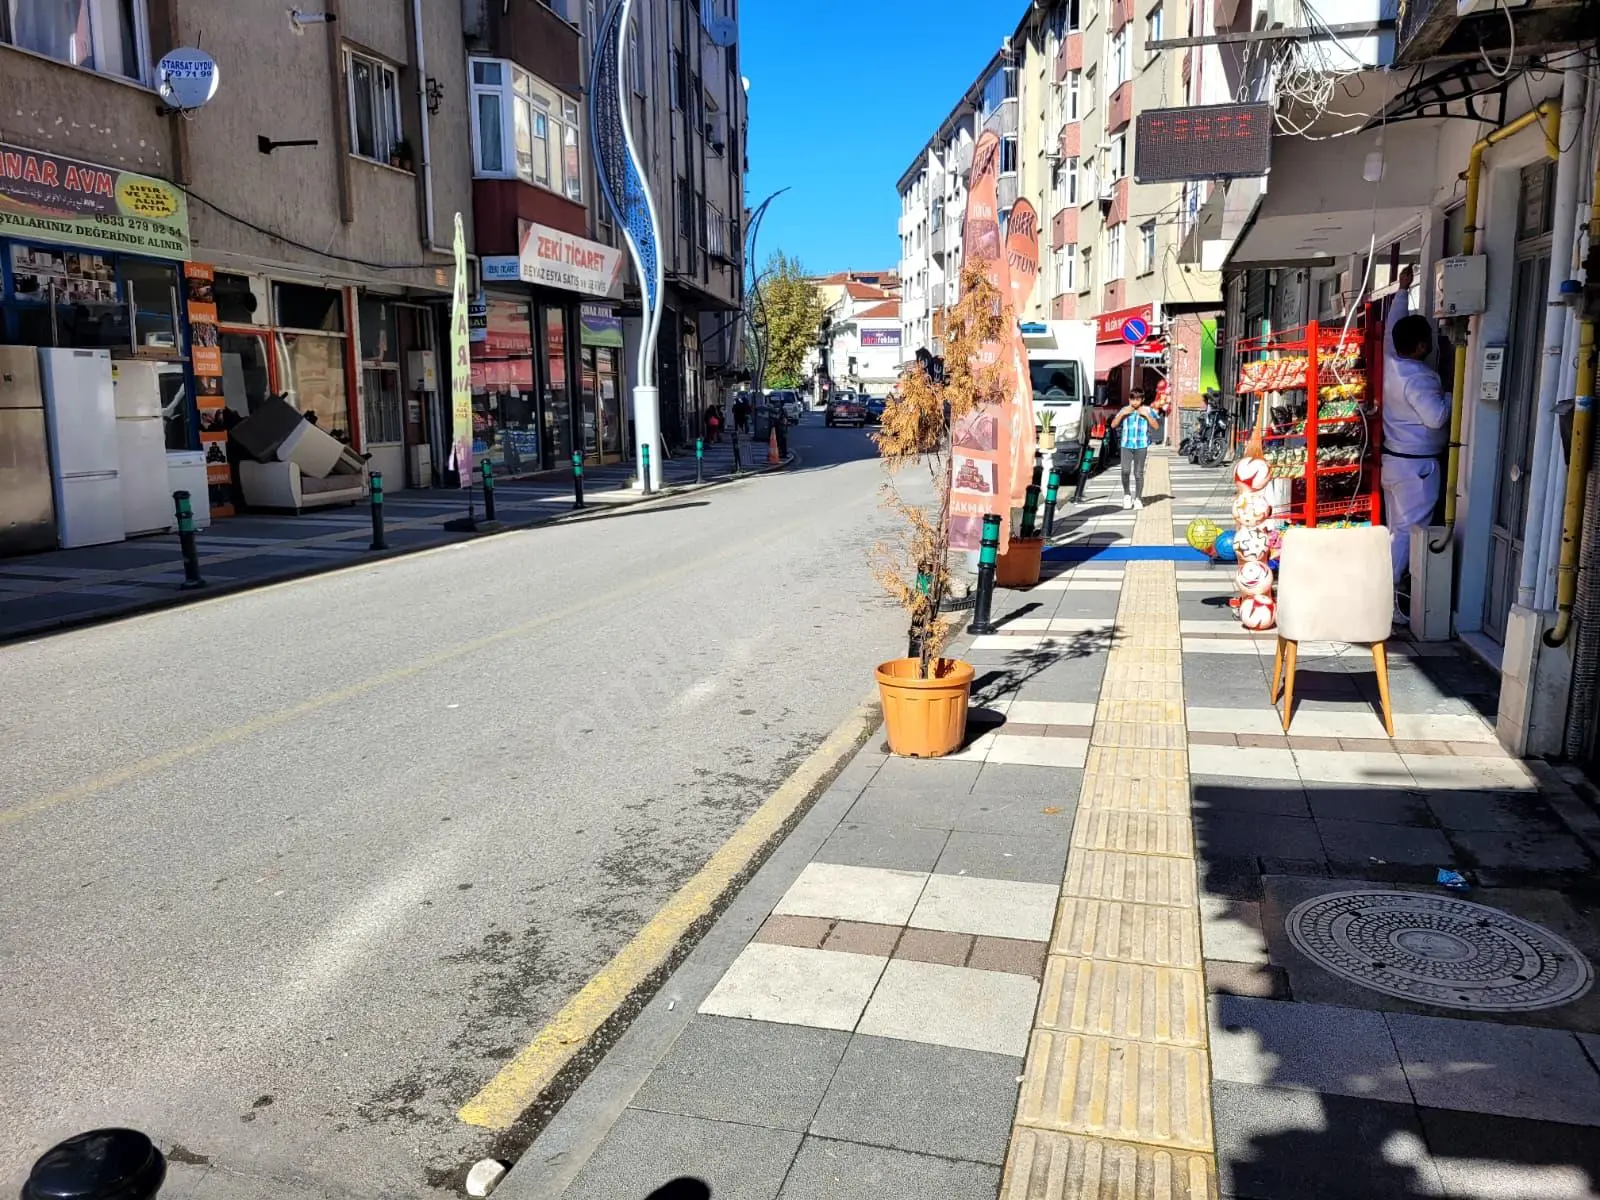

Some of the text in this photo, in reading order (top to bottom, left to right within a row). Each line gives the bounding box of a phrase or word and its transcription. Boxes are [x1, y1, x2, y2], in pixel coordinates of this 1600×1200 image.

[162, 60, 193, 70] STARSAT
[64, 165, 114, 198] AVM
[95, 213, 182, 237] 0533 279 92 54
[76, 226, 145, 246] DEĞERİNDE
[147, 237, 183, 251] ALINIR
[537, 236, 606, 273] ZEKİ TİCARET
[523, 263, 544, 280] BEYAZ
